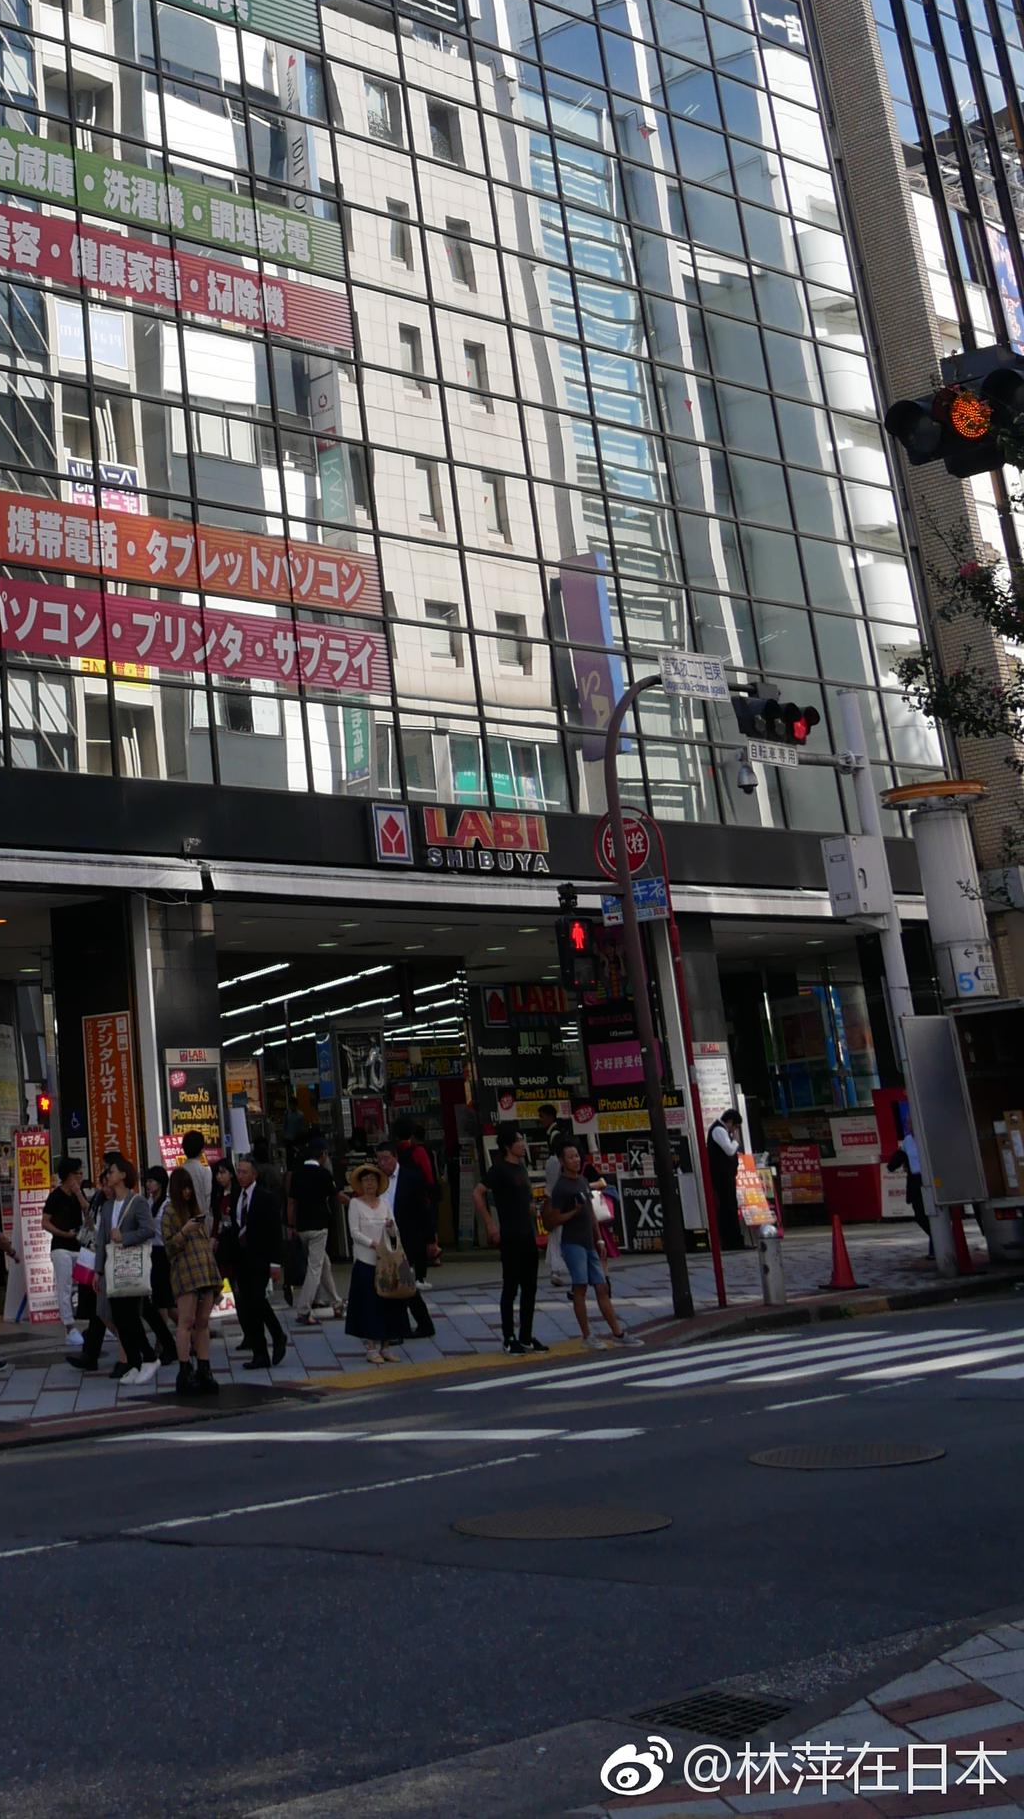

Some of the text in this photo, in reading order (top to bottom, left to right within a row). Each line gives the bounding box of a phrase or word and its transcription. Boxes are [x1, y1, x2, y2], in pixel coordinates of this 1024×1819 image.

[7, 505, 363, 605] 携帯電話・タブレットパソコン
[751, 744, 796, 764] 自転車専用
[423, 806, 549, 852] LABI
[427, 847, 550, 873] SHIBUYA
[959, 972, 975, 992] 5
[517, 1046, 543, 1055] SONY
[482, 1077, 514, 1086] TOSHIBA
[519, 1076, 549, 1086] SHARP
